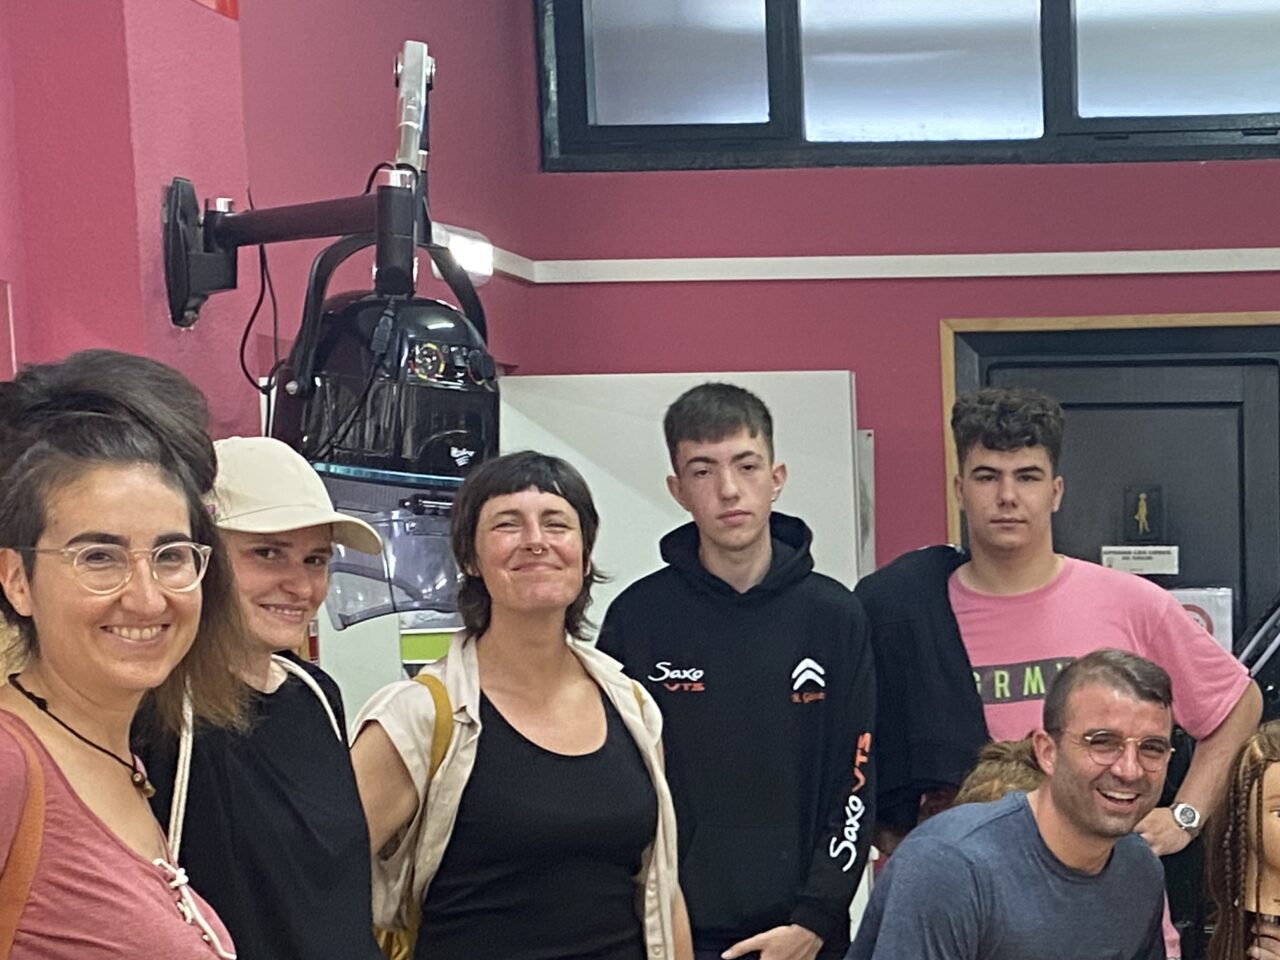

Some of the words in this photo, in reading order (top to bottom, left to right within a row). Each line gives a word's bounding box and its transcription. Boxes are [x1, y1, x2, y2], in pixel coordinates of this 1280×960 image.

[648, 662, 704, 681] Saxo
[973, 662, 1072, 698] RM
[829, 795, 865, 872] Saxo
[851, 732, 871, 793] VTS
